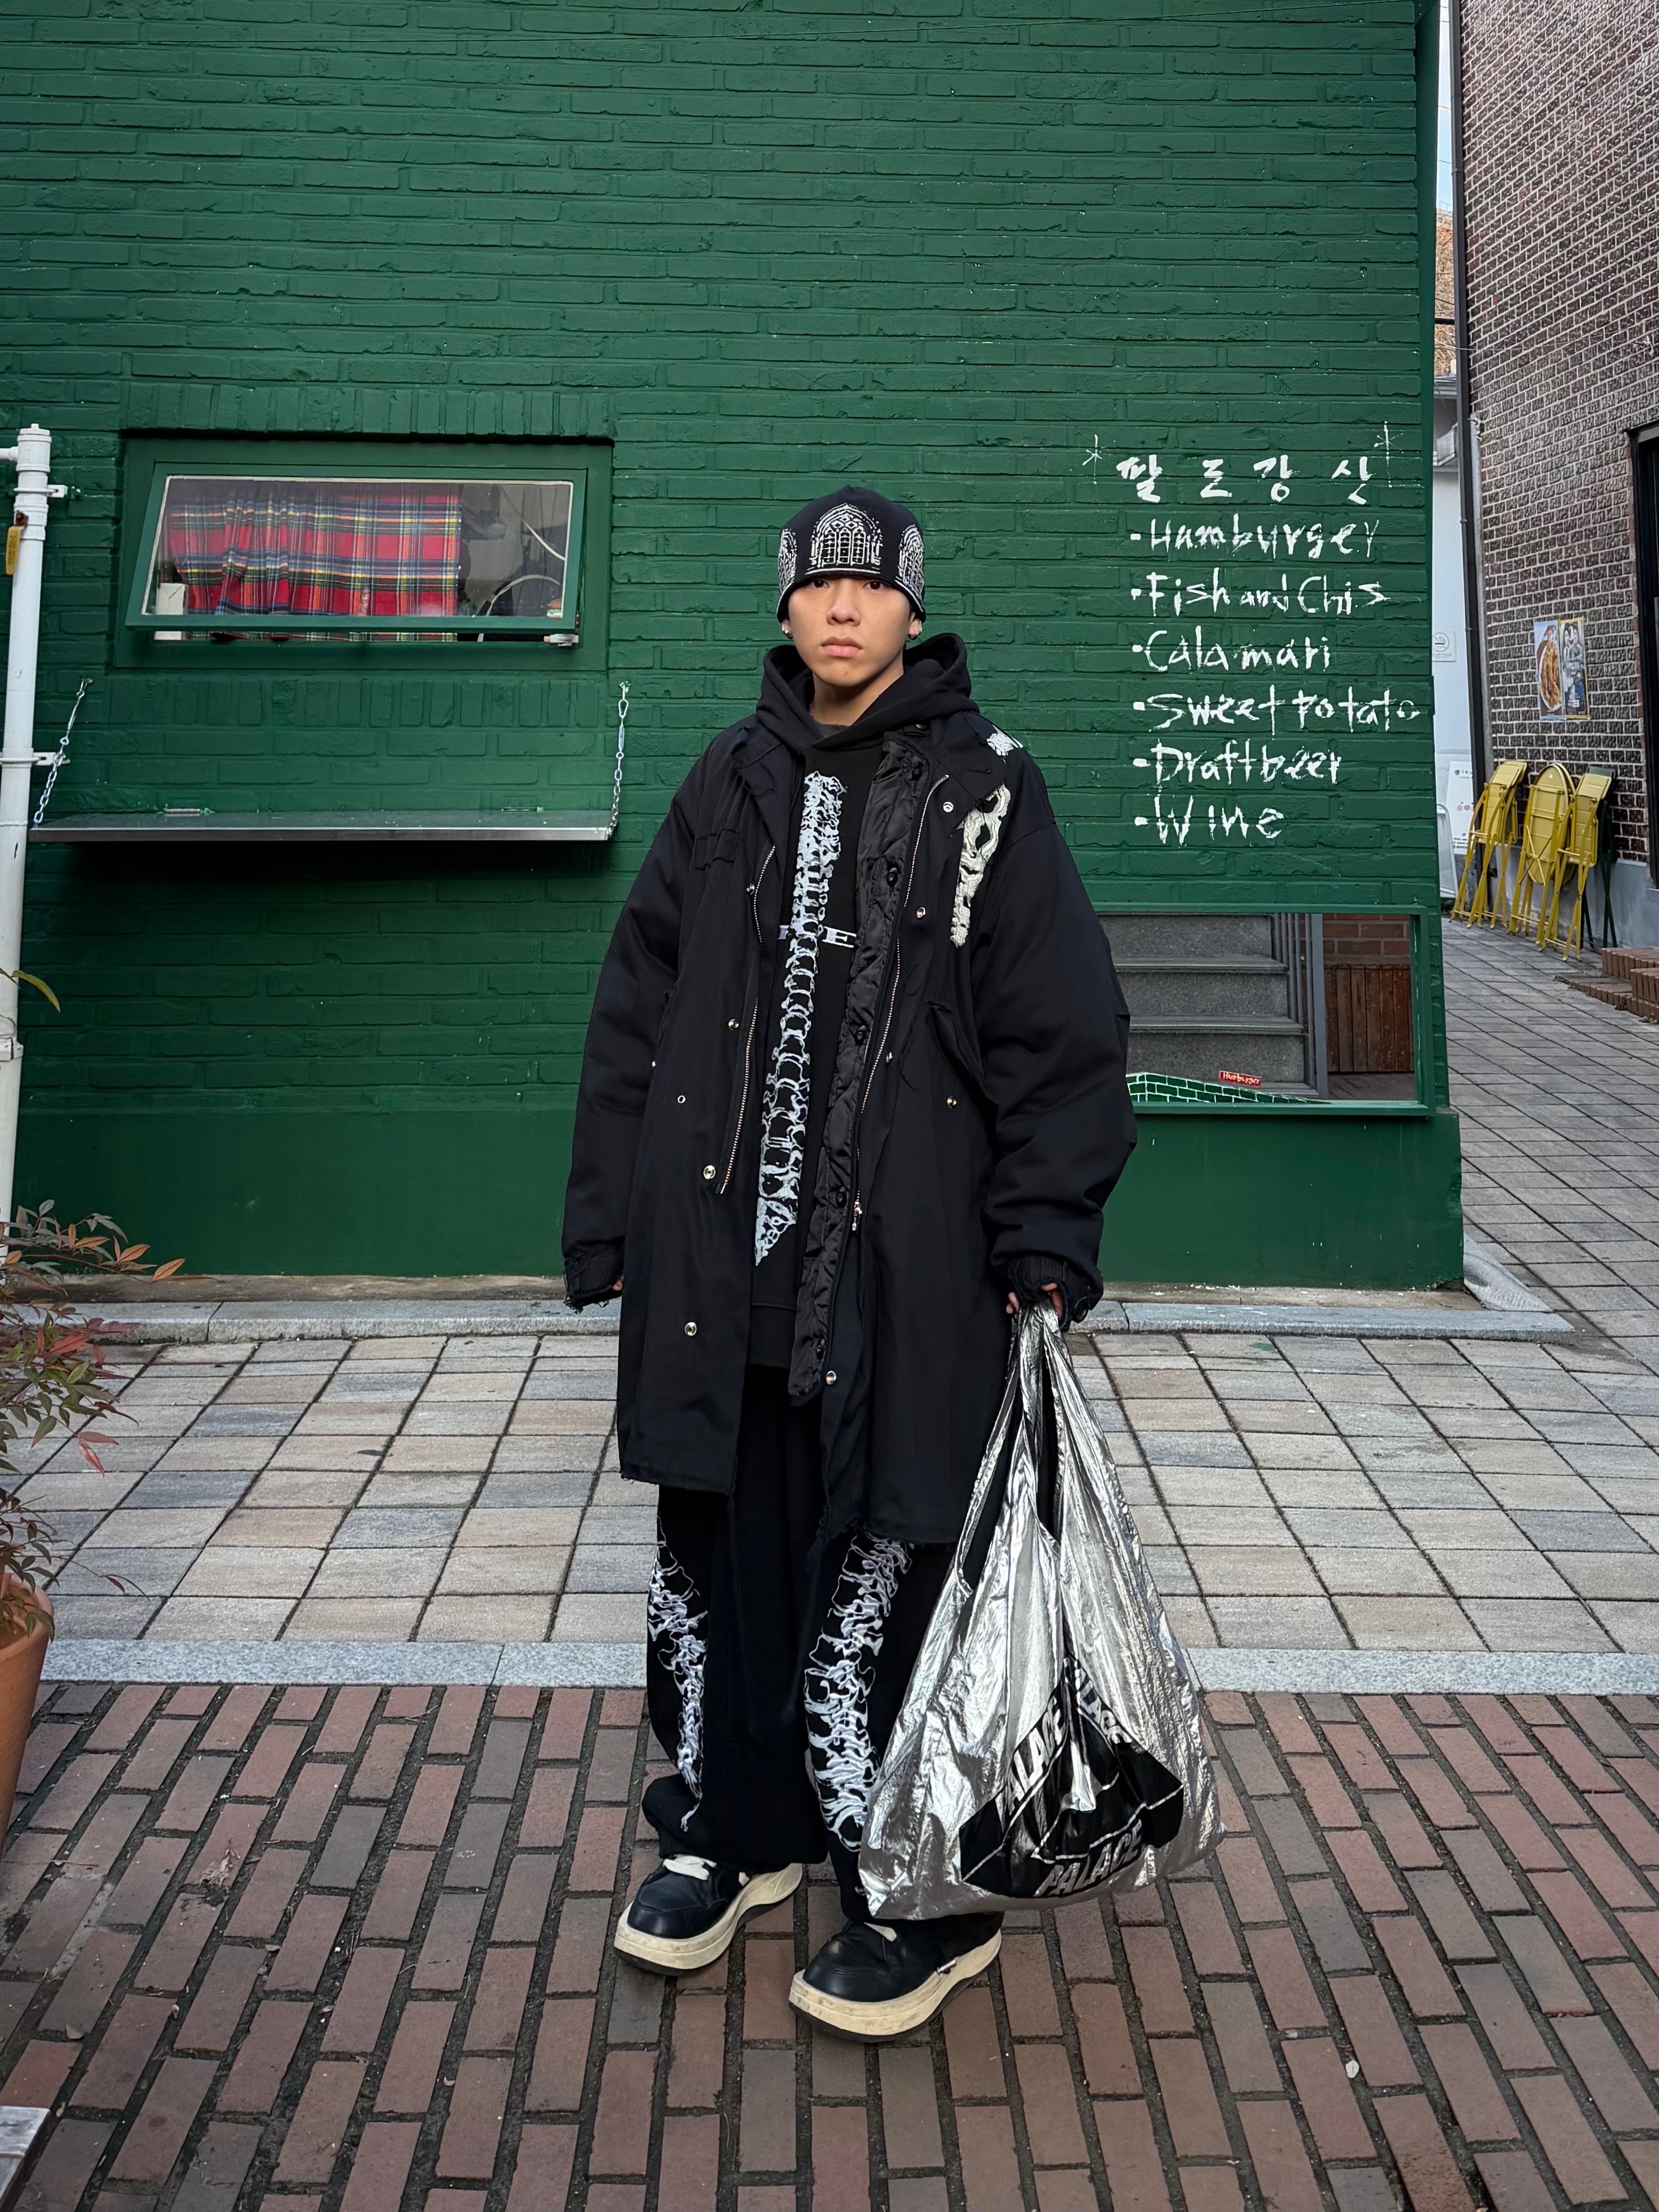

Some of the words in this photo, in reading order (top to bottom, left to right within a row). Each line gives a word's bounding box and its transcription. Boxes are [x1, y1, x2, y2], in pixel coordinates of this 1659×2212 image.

[1144, 626, 1331, 672] Calamari
[1146, 684, 1286, 736] Sweet
[1033, 1818, 1143, 1897] PALACE
